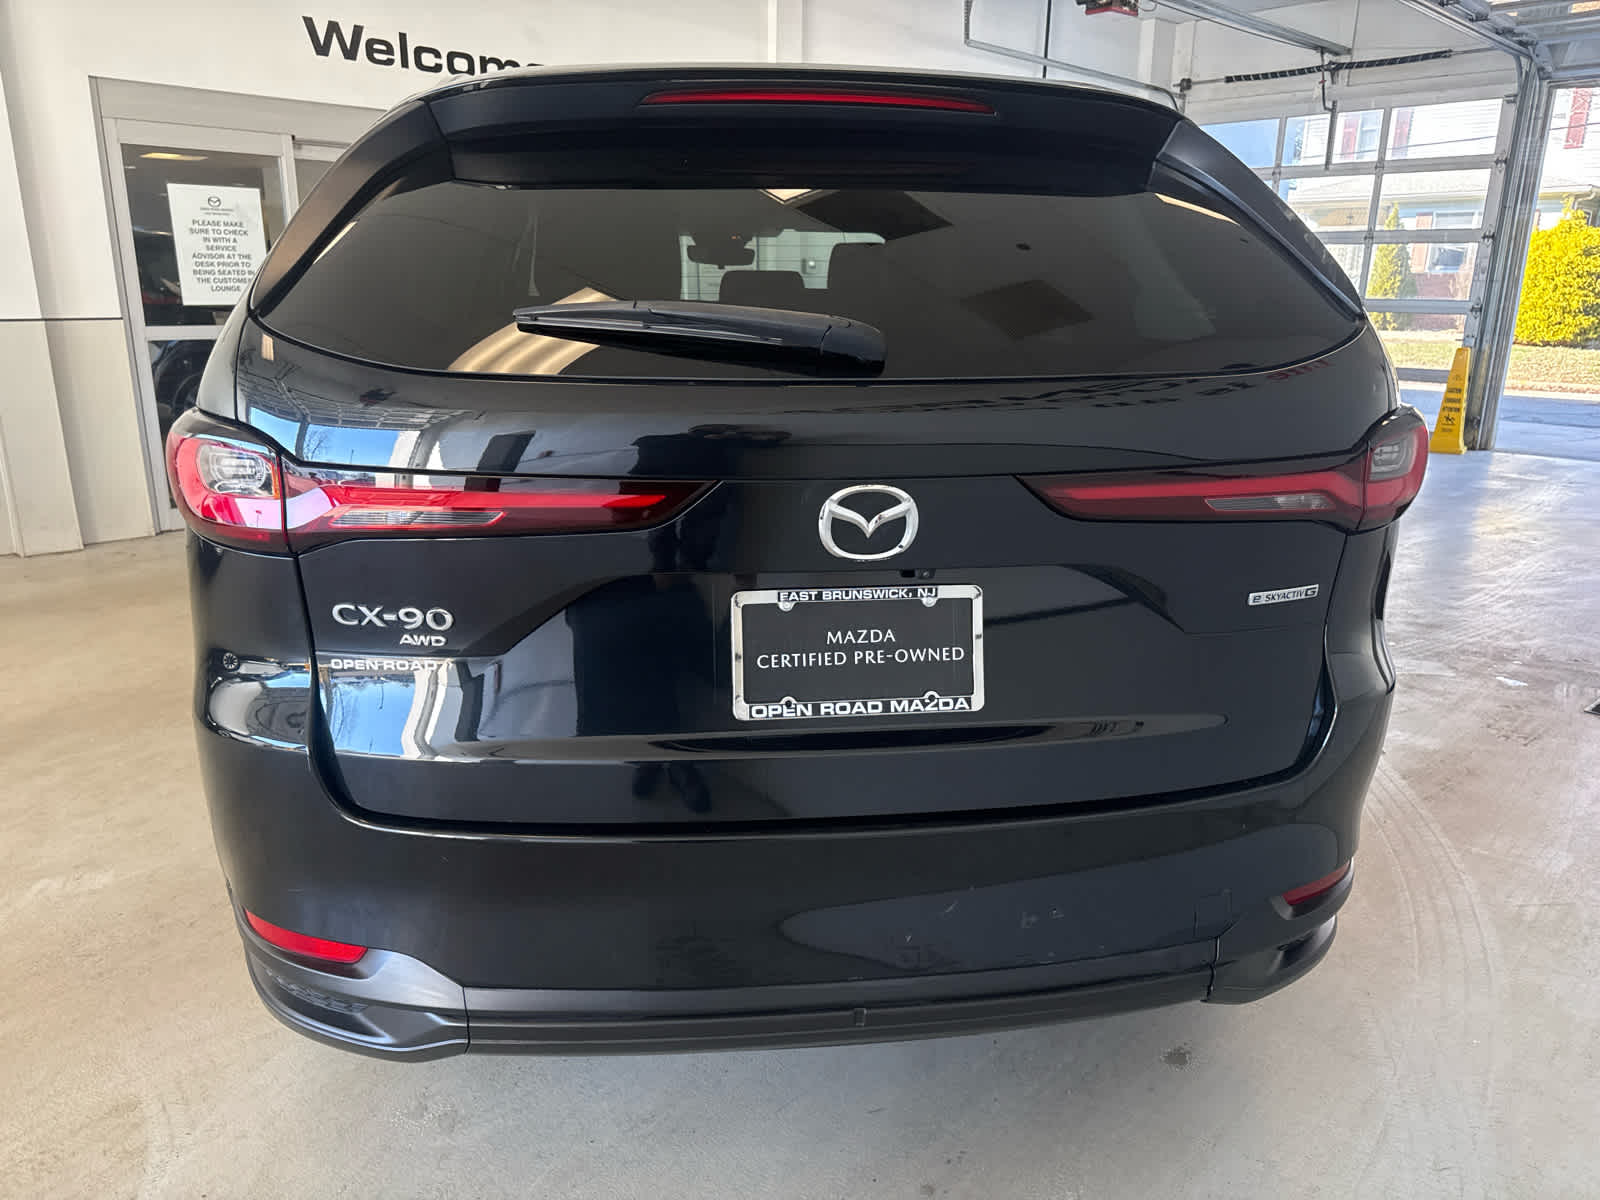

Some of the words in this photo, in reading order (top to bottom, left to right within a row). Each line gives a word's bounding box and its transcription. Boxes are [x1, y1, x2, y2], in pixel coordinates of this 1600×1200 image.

[301, 15, 546, 76] Welcom
[192, 218, 222, 228] PLEASE
[223, 220, 245, 228] MAKE
[189, 227, 210, 235] SURE
[211, 228, 222, 236] TO
[223, 229, 249, 237] CHECK
[212, 236, 231, 244] WITH
[205, 244, 237, 252] SERVICE
[192, 252, 225, 260] ADVISOR
[237, 253, 252, 261] THE
[217, 261, 240, 269] PRIOR
[241, 261, 251, 269] TO
[211, 285, 242, 293] LOUNGE
[780, 590, 818, 602] EAST
[822, 588, 913, 601] BRUNSWICK,
[917, 587, 937, 598] NJ
[331, 603, 454, 631] CX-90
[399, 633, 447, 647] AWD
[826, 628, 896, 645] MAZDA
[756, 652, 847, 669] CERTIFIED
[854, 646, 965, 665] PRE-OWNED
[330, 658, 379, 671] OPEN
[383, 659, 438, 672] ROAD
[751, 702, 813, 718] OPEN
[820, 700, 889, 717] ROAD
